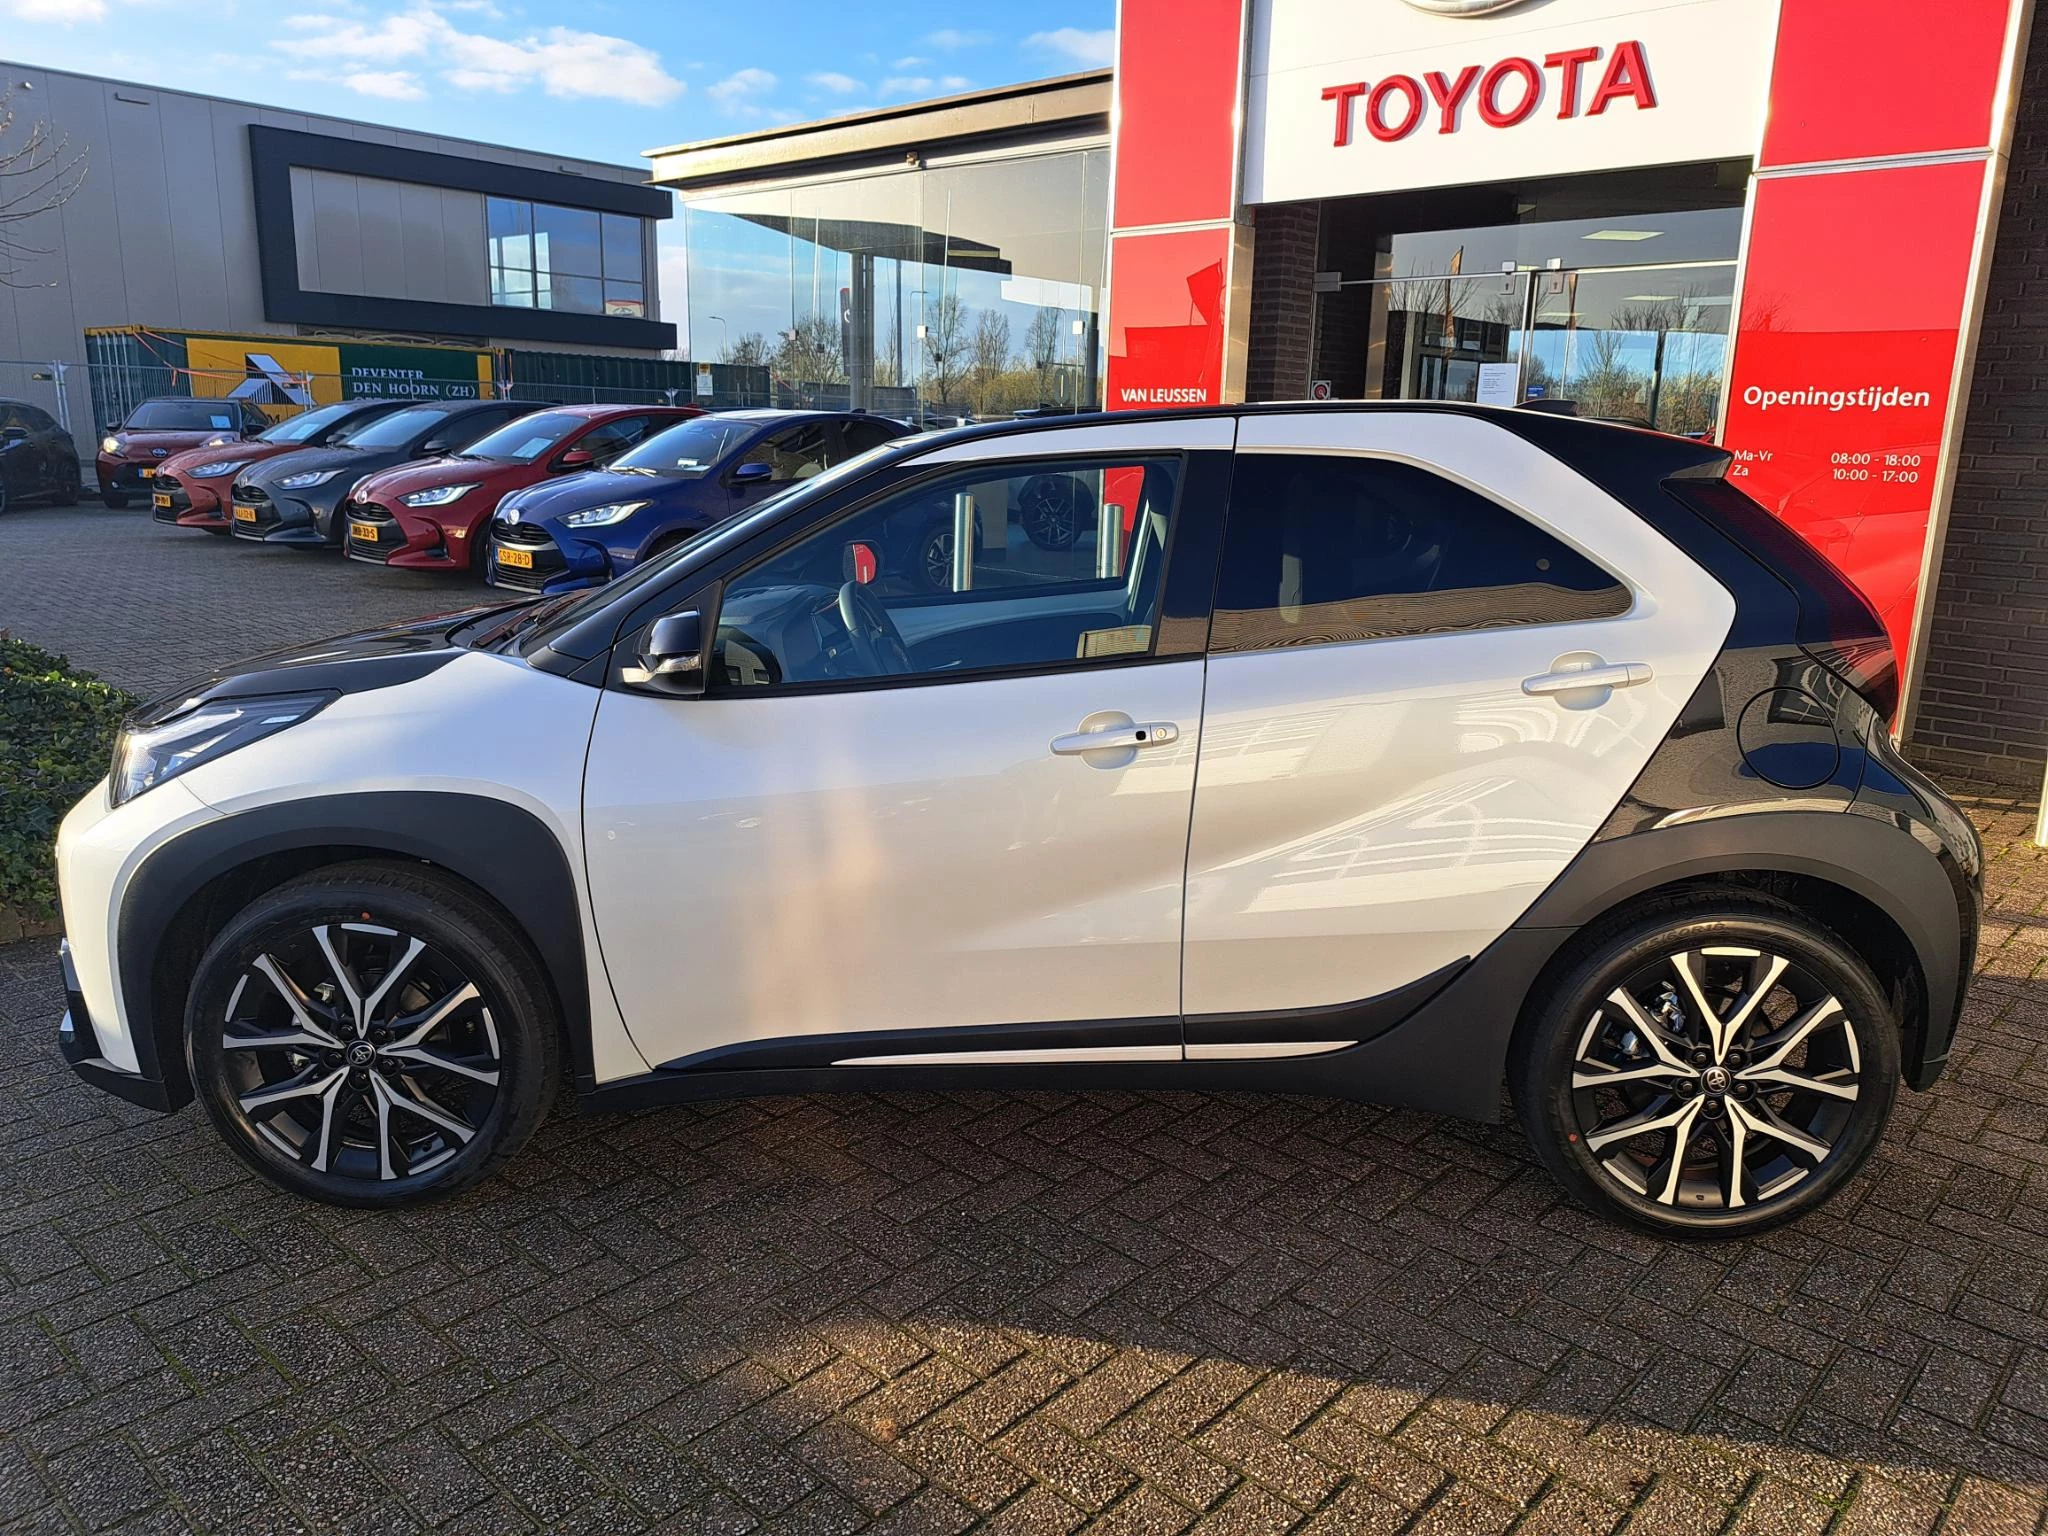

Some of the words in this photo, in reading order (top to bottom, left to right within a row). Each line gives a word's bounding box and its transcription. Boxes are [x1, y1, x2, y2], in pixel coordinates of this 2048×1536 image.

[1321, 40, 1658, 147] TOYOTA
[351, 367, 424, 380] DEVENTER
[353, 382, 382, 393] DEN
[389, 383, 439, 396] HOORN
[445, 384, 476, 398] (ZH)
[1121, 388, 1147, 402] VAN
[1150, 388, 1207, 402] LEUSSEN
[1743, 385, 1931, 412] Openingstijden
[1734, 450, 1773, 461] Ma-Vr
[1830, 452, 1871, 465] 08:00
[1884, 454, 1921, 467] 18:00
[1732, 465, 1749, 476] Za
[1833, 468, 1869, 481] 10:00
[1882, 471, 1919, 483] 17:00
